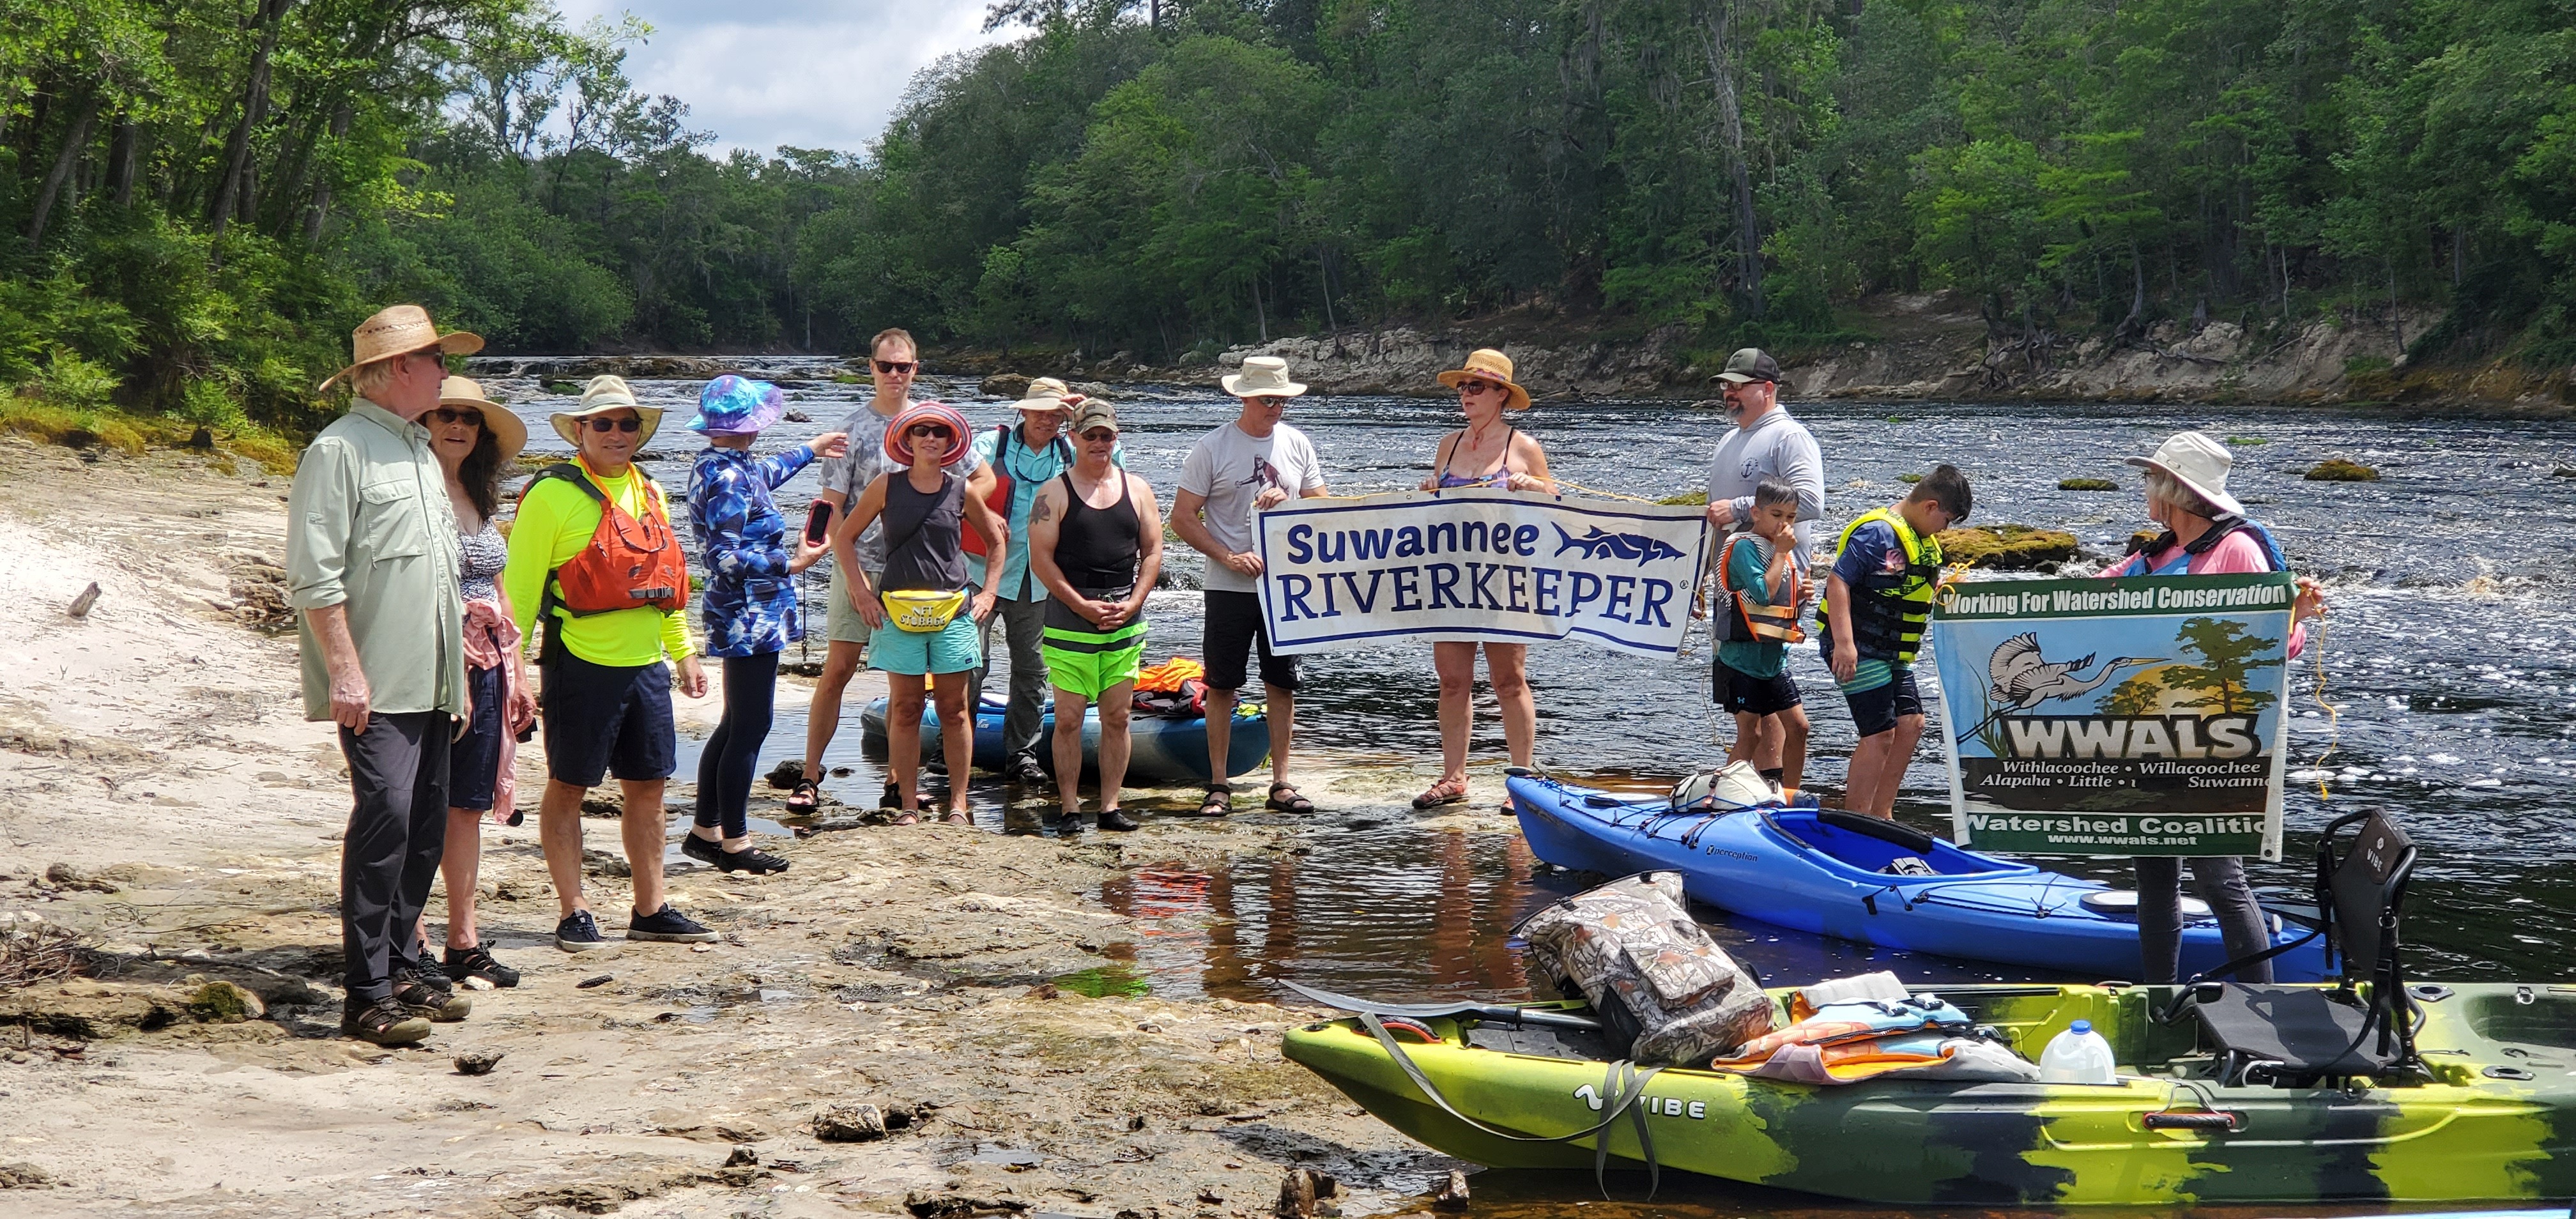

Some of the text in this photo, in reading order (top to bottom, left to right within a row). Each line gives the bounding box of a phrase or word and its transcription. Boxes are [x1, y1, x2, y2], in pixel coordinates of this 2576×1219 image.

[1287, 521, 1540, 564] Suwannee
[1943, 583, 2287, 615] Working For Watershed Conservation
[912, 606, 934, 617] NFT
[2008, 718, 2255, 758] WWALS
[2002, 761, 2260, 775] Withlacoochee Willacoochee
[1979, 774, 2051, 788] Alapaha
[2068, 776, 2112, 788] Little
[1967, 815, 2128, 834] Watershed
[2048, 834, 2198, 846] www.wwals.net
[1714, 848, 1758, 862] perception
[2367, 848, 2382, 872] VIBE
